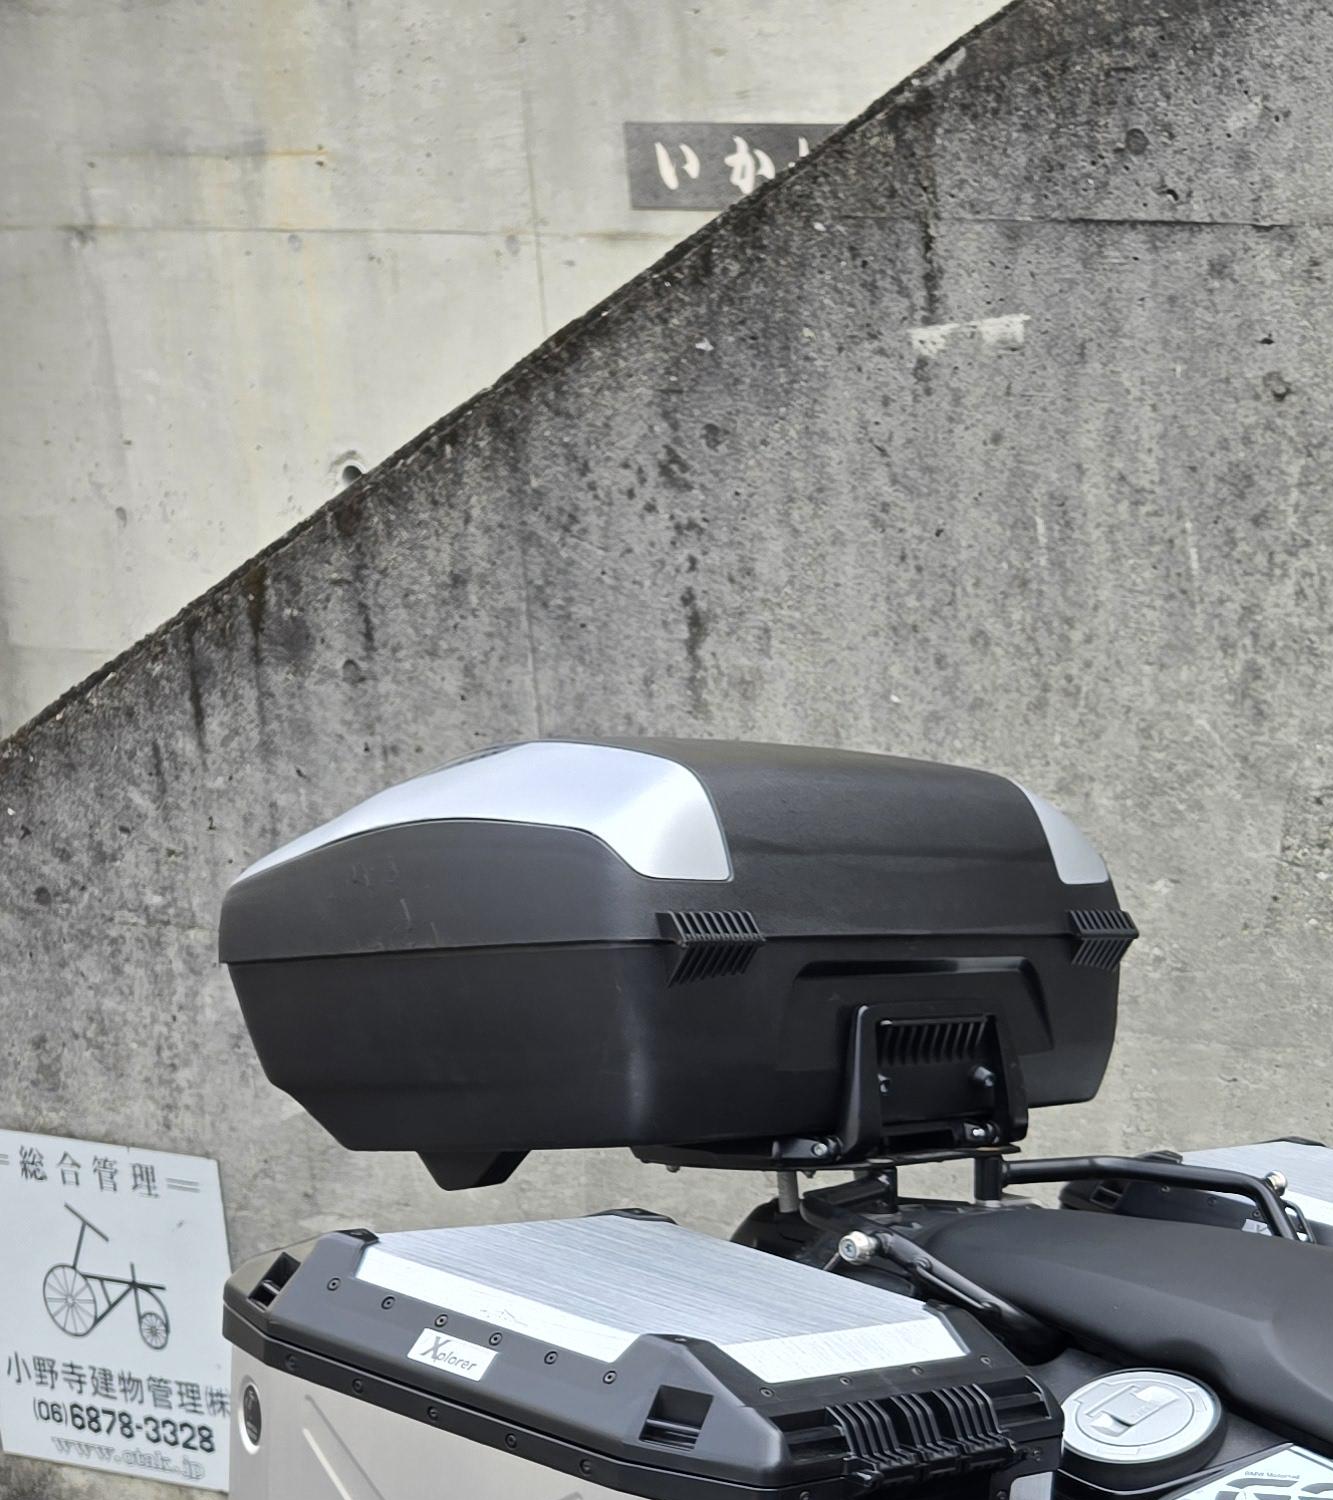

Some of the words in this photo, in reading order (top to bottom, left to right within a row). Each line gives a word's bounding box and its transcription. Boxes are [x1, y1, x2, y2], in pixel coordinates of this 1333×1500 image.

[655, 135, 810, 195] いわ
[19, 1145, 160, 1199] 総合管理
[420, 1335, 478, 1371] Xplorer
[33, 1396, 216, 1453] (06)6878-3328
